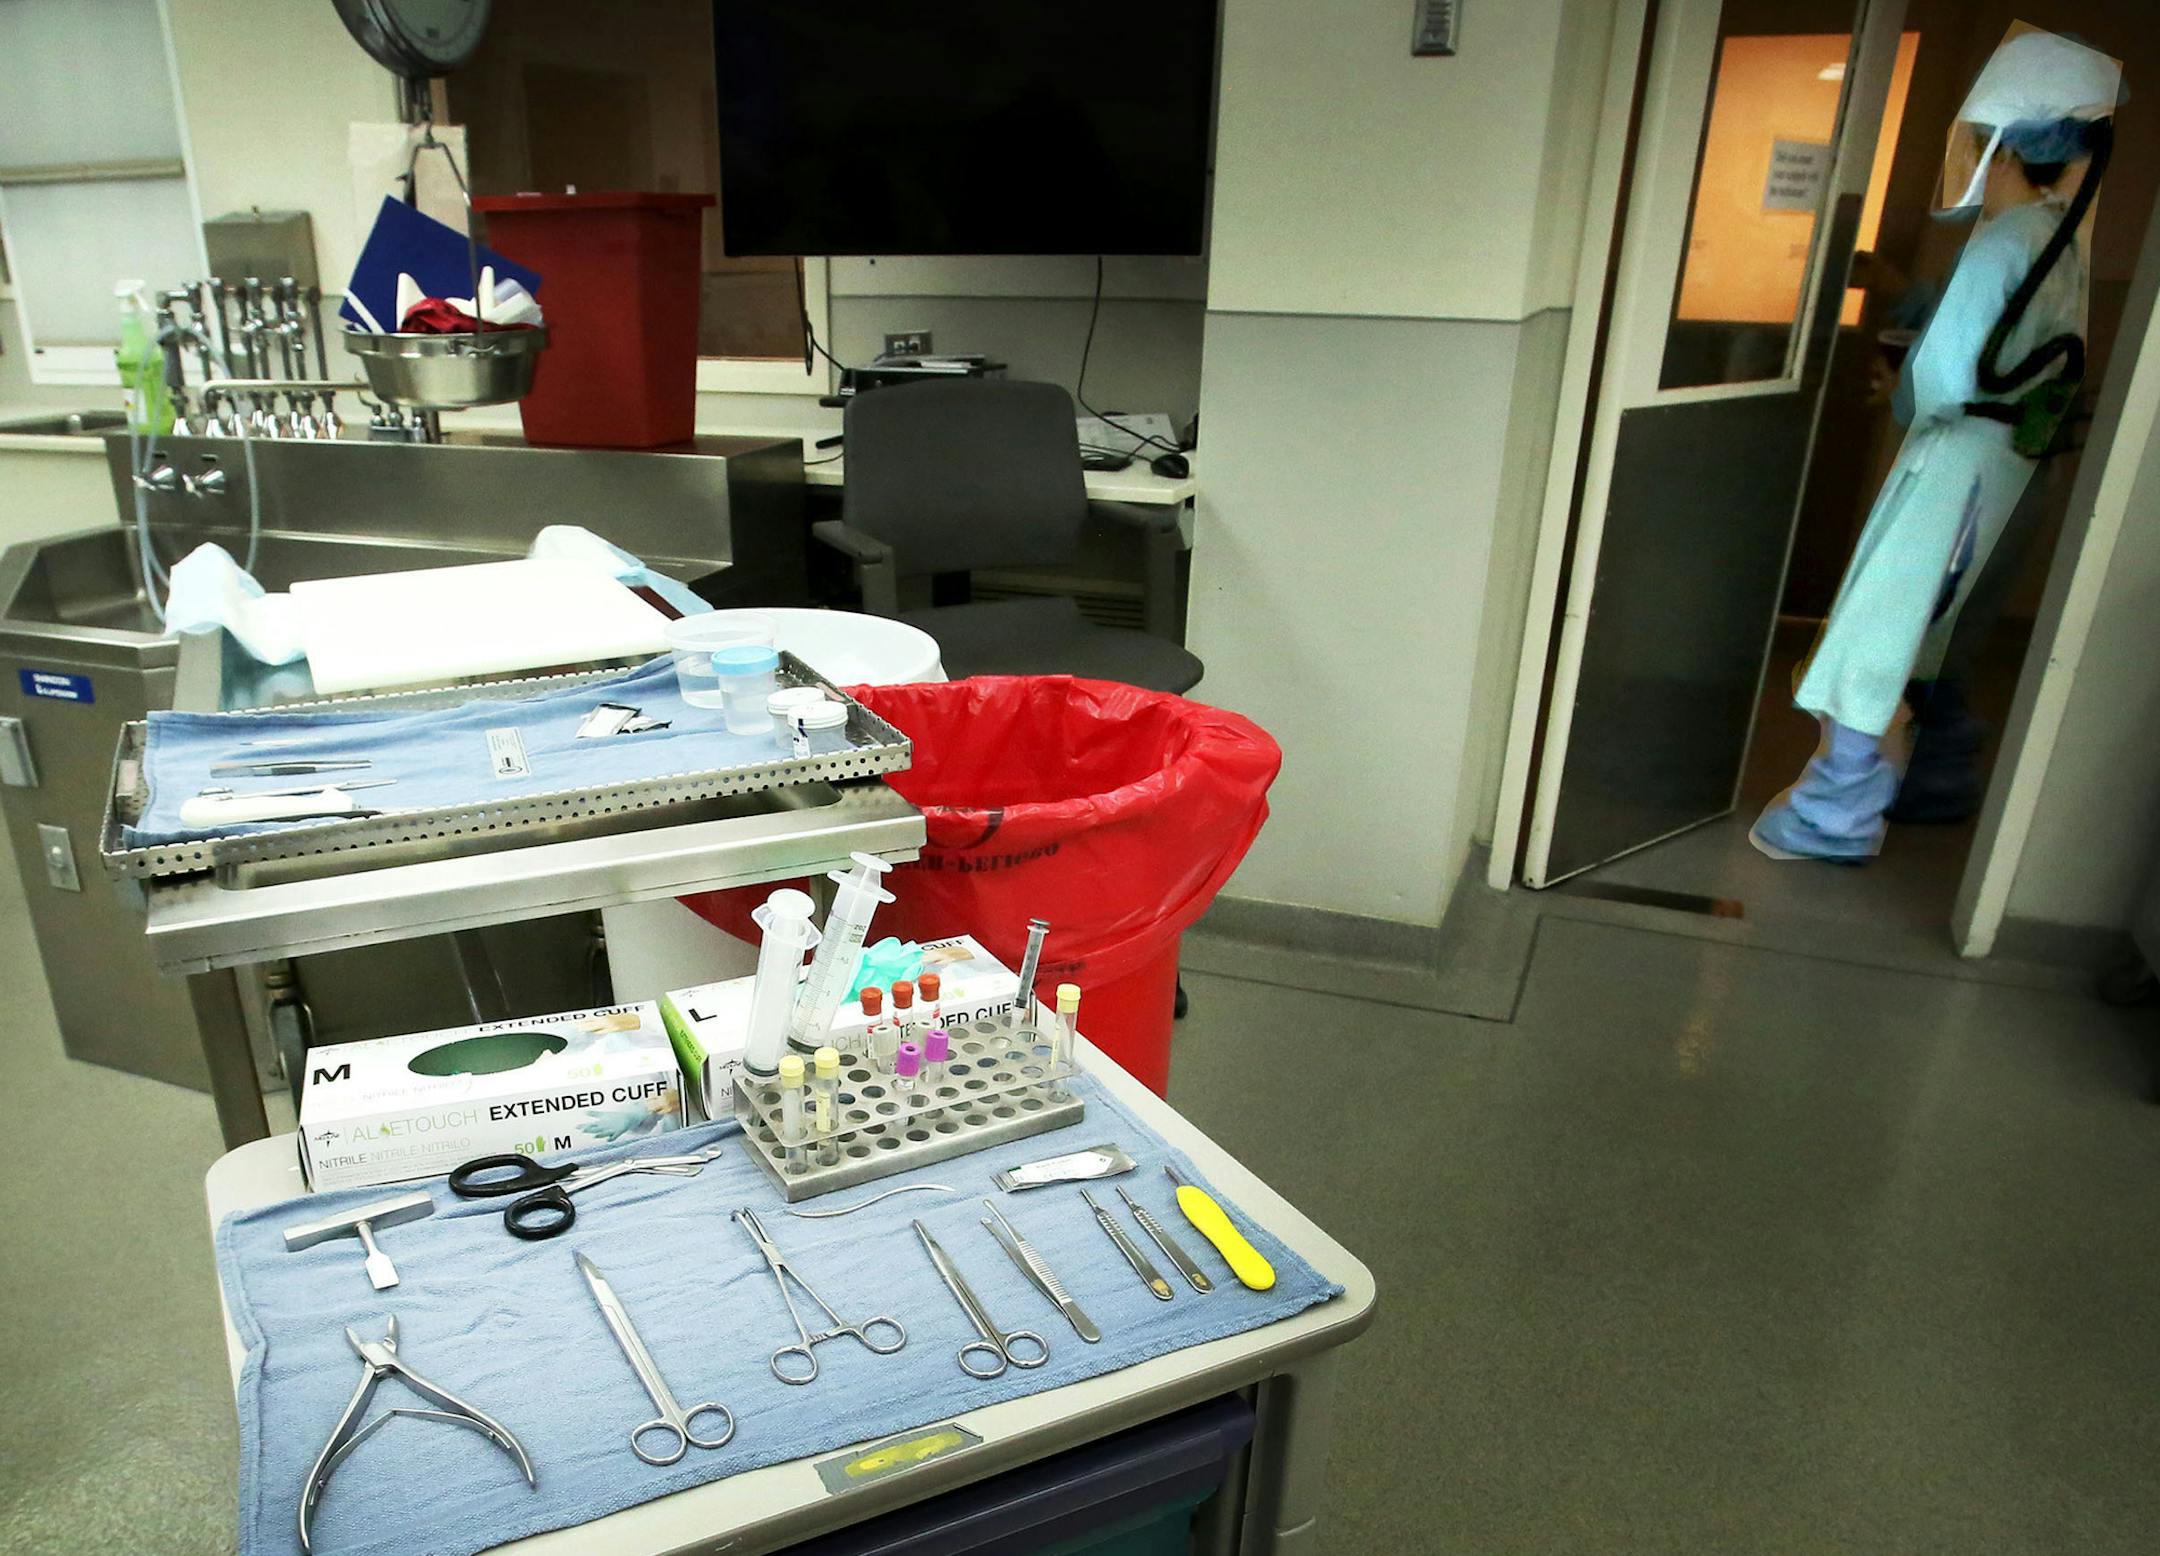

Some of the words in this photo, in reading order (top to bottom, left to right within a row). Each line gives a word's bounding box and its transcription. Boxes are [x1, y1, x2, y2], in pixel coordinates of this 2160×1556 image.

[921, 938, 964, 951] CUFF
[479, 1012, 587, 1032] EXTENDED
[594, 1004, 645, 1018] CUFF
[688, 1008, 717, 1022] L
[313, 1063, 350, 1085] M
[489, 1091, 604, 1121] EXTENDED
[612, 1081, 667, 1102] CUFF
[319, 1153, 367, 1169] NITRILE
[371, 1144, 417, 1161] NITRILE
[422, 1137, 471, 1154] NITRILO
[515, 1142, 535, 1156] 50
[554, 1135, 572, 1150] M
